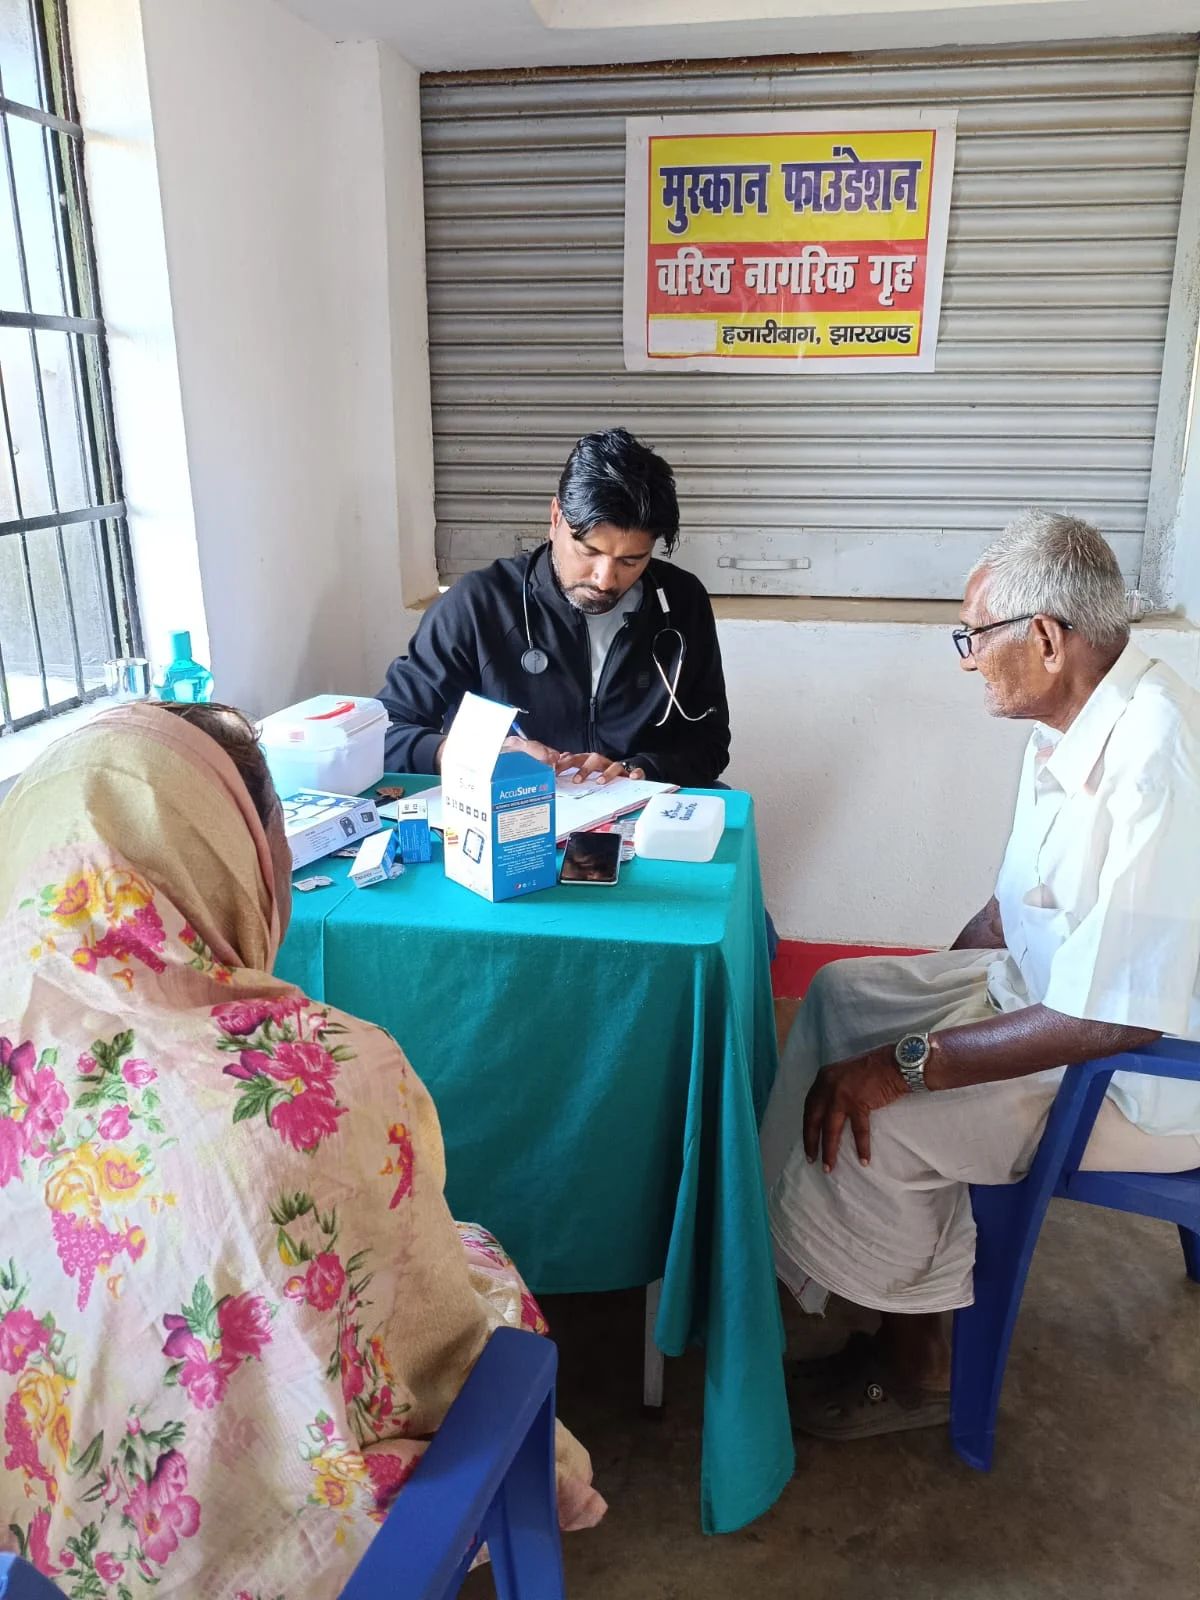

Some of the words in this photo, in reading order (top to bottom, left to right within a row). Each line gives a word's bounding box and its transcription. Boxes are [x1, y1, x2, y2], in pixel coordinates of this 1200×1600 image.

[660, 164, 771, 234] मुस्कान
[781, 147, 922, 212] फाउंडेशन
[655, 247, 735, 296] वरिष्ठ
[743, 245, 859, 296] नागरिक
[867, 254, 917, 307] गृह
[829, 324, 913, 345] झारखण्ड
[499, 786, 537, 801] AccuSure
